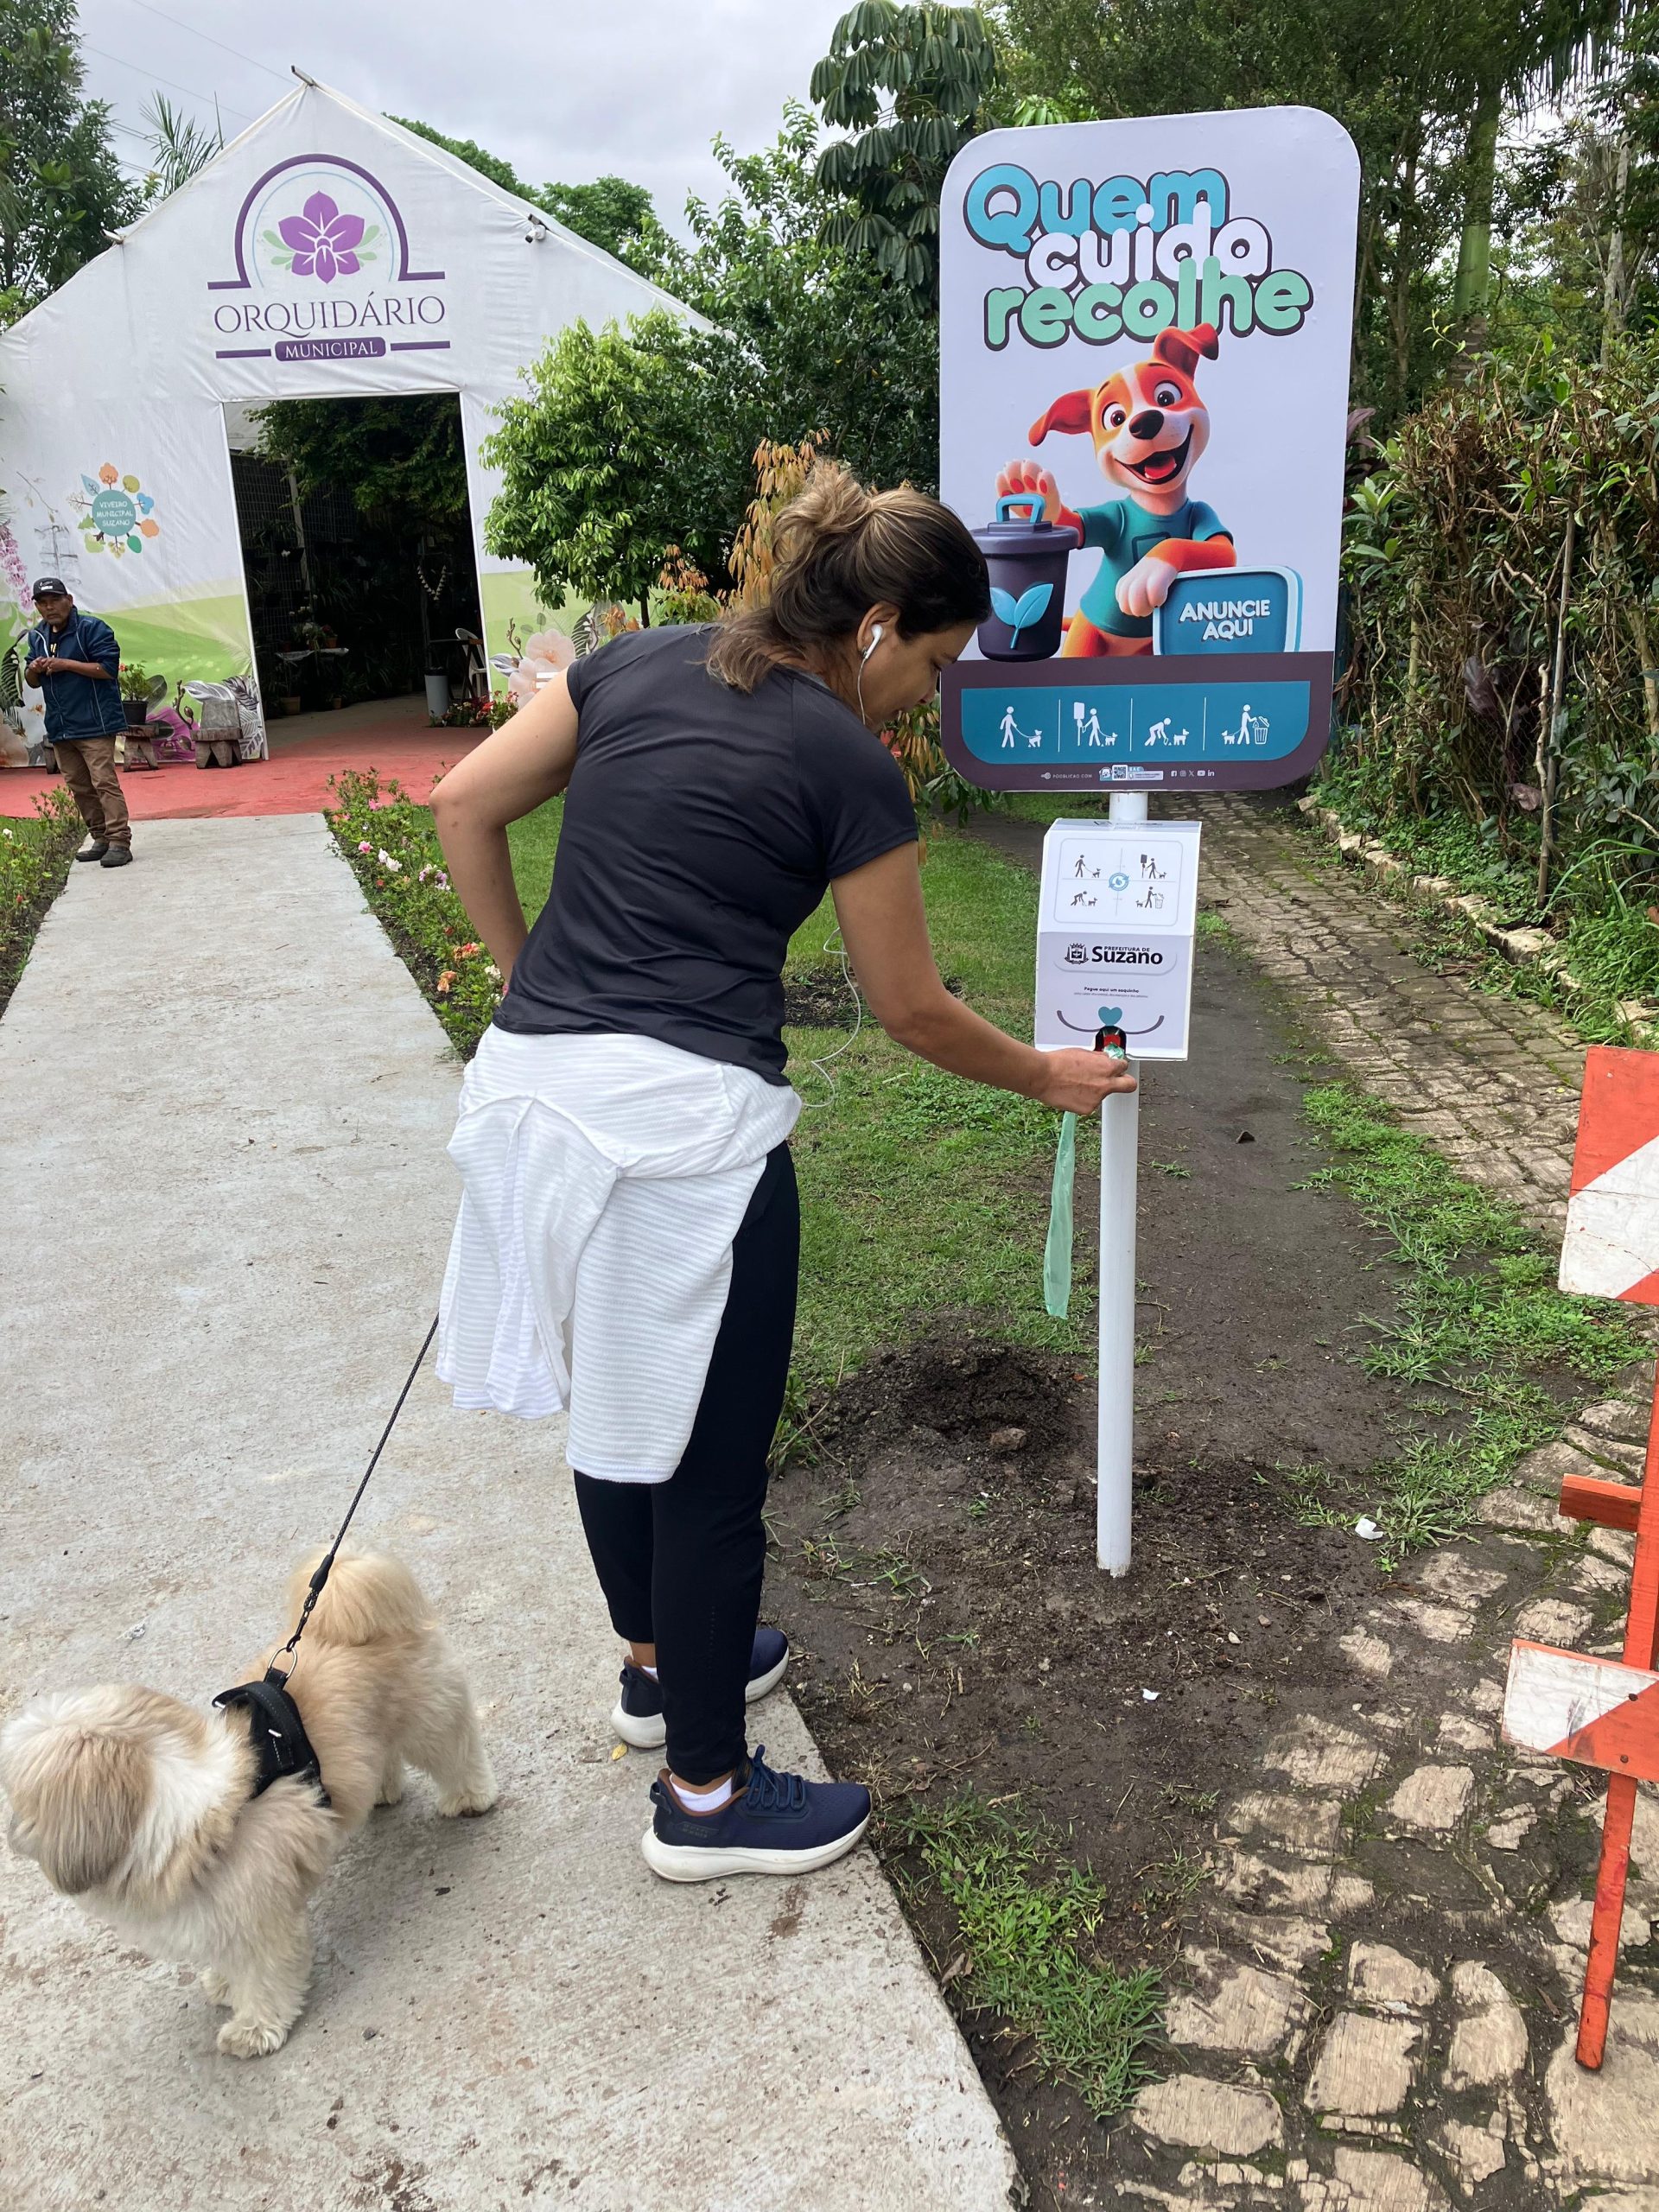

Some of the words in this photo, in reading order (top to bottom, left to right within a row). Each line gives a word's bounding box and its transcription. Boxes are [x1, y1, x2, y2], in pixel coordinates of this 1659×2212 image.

[963, 162, 1230, 258] Quem
[1025, 200, 1274, 292] cuida
[213, 291, 446, 339] ORQUIDÁRIO
[983, 255, 1314, 352] recolhe
[284, 340, 378, 359] MUNICIPAL
[1179, 599, 1271, 623] ANUNCIE
[1202, 618, 1253, 641] AQUI
[1091, 945, 1163, 964] Suzano
